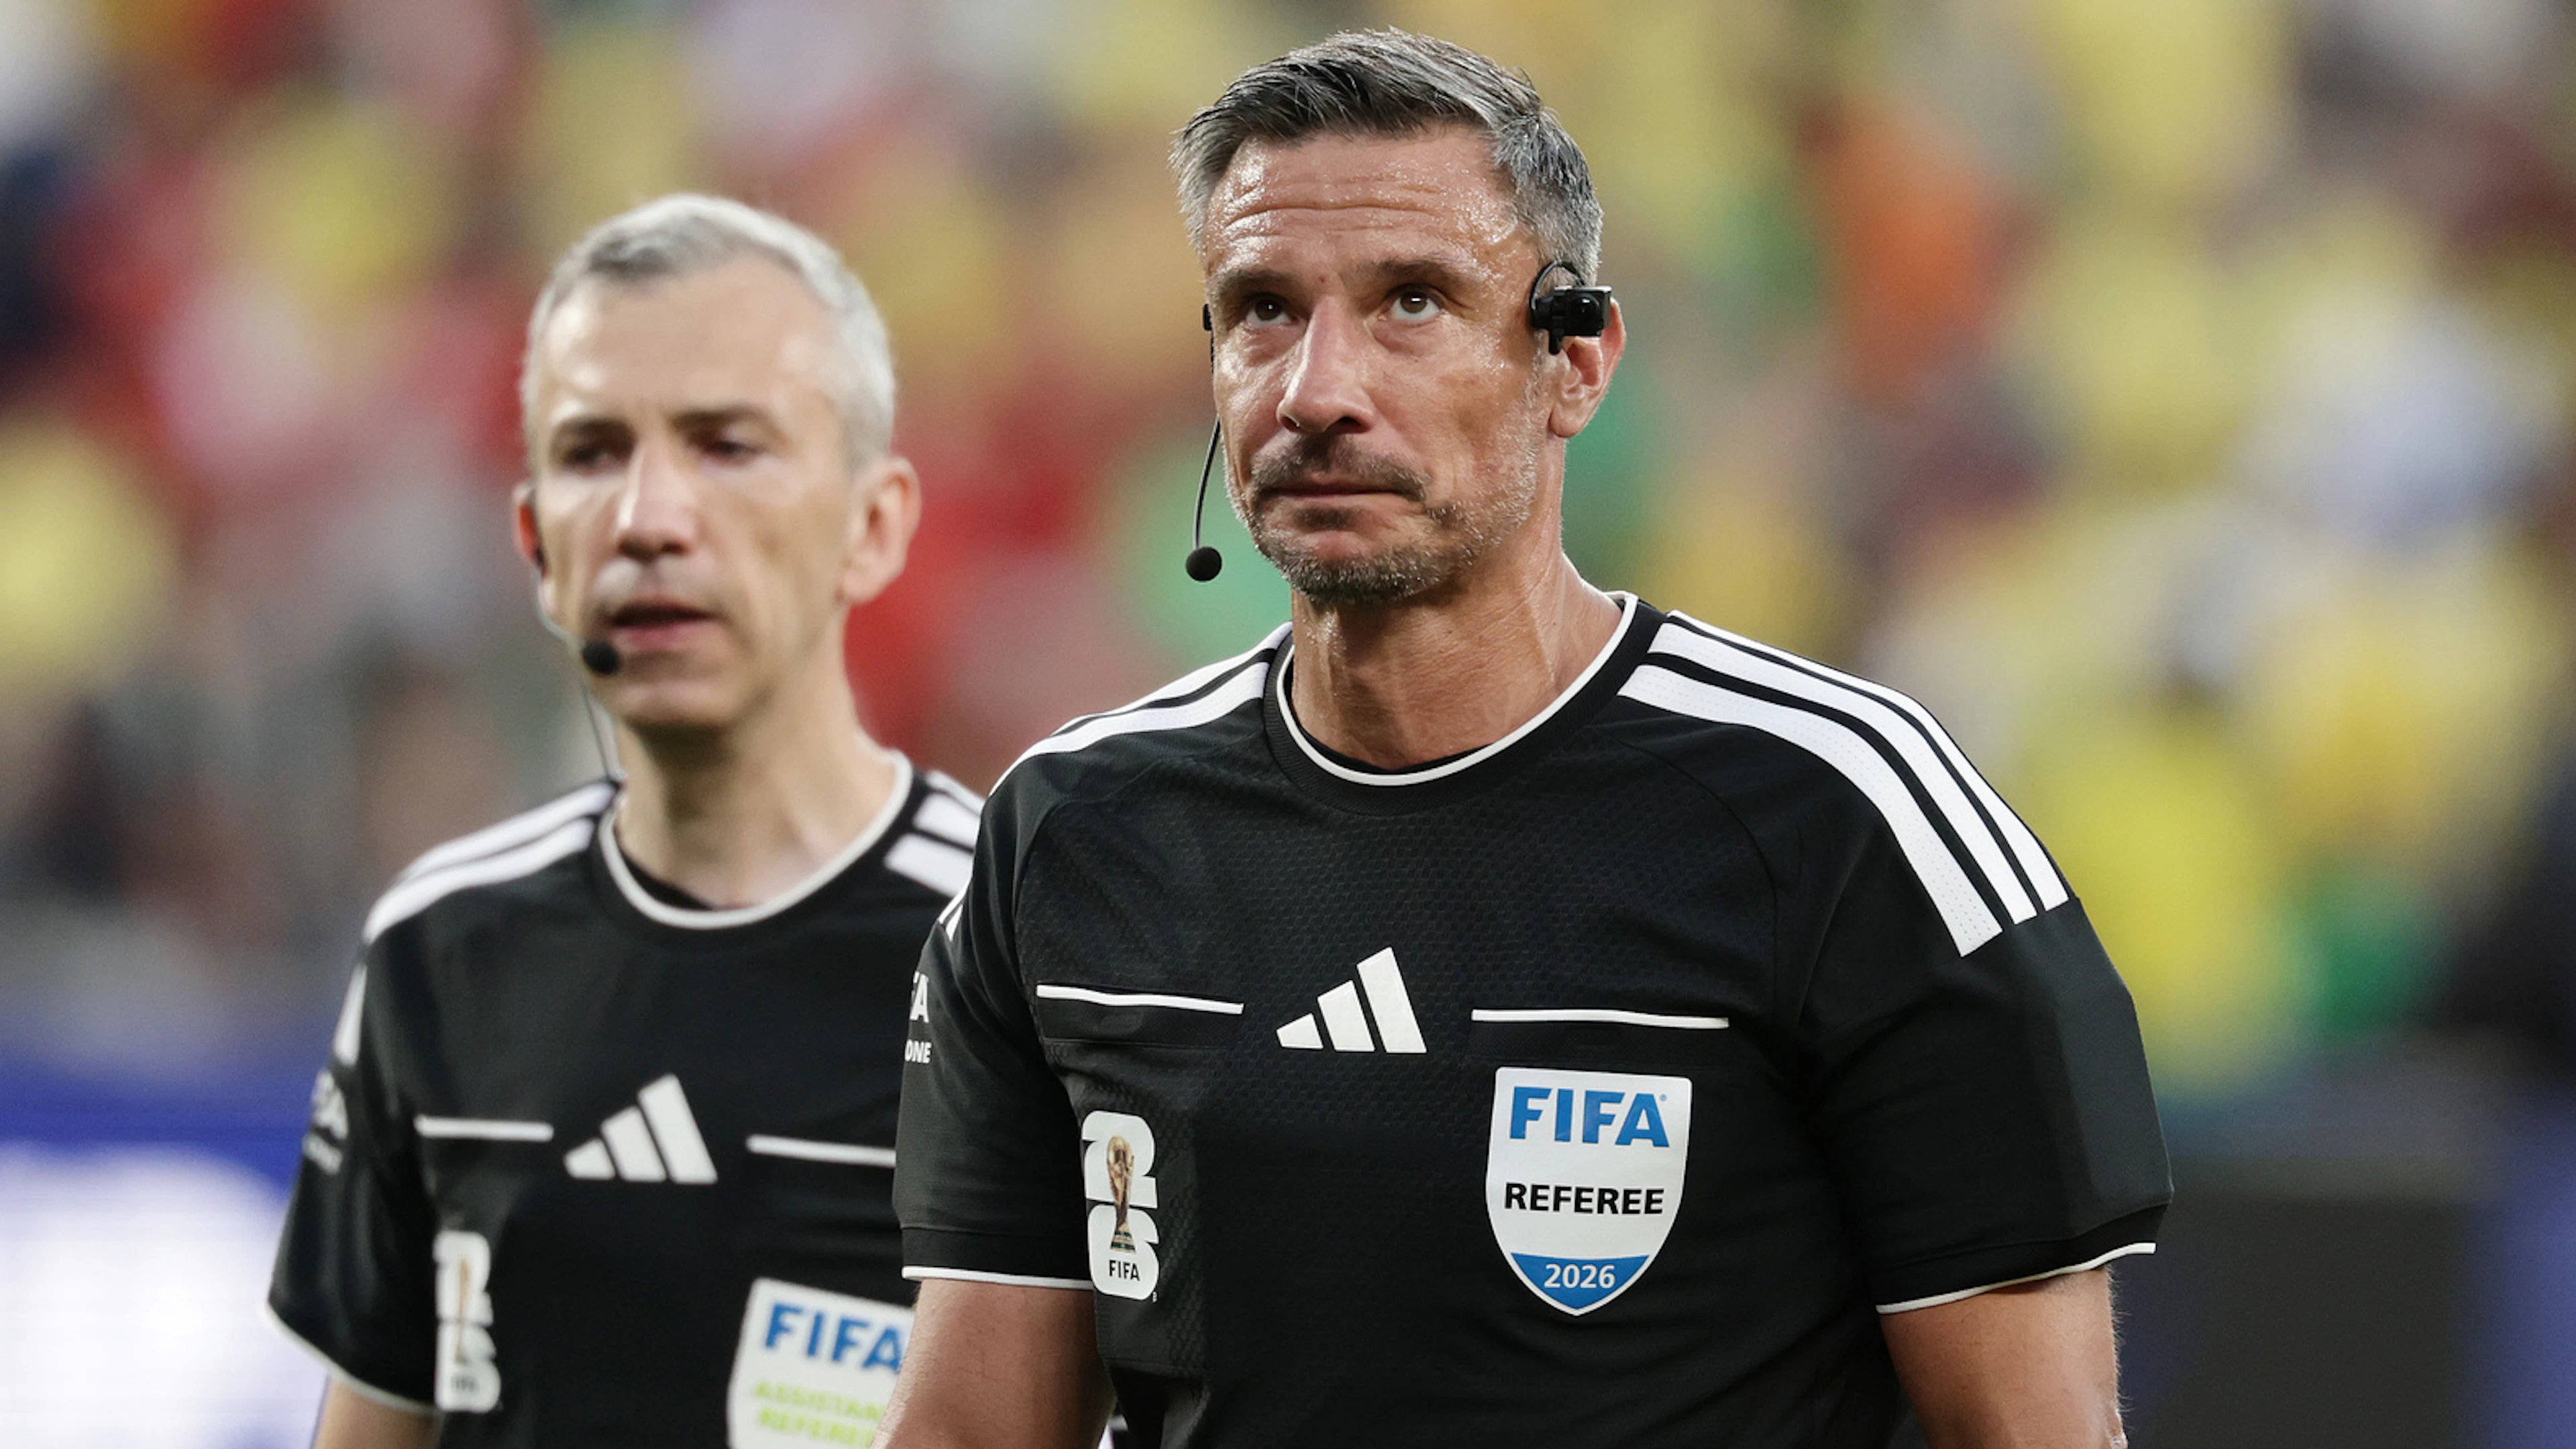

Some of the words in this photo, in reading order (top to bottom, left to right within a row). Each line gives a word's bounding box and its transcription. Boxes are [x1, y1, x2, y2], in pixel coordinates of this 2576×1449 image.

[905, 1039, 932, 1064] ONE
[1509, 1087, 1670, 1147] FIFA
[1504, 1183, 1664, 1214] REFEREE
[1109, 1260, 1140, 1281] FIFA
[1544, 1263, 1616, 1289] 2026
[765, 1303, 905, 1375] FIFA
[753, 1380, 885, 1421] ASSISTAN
